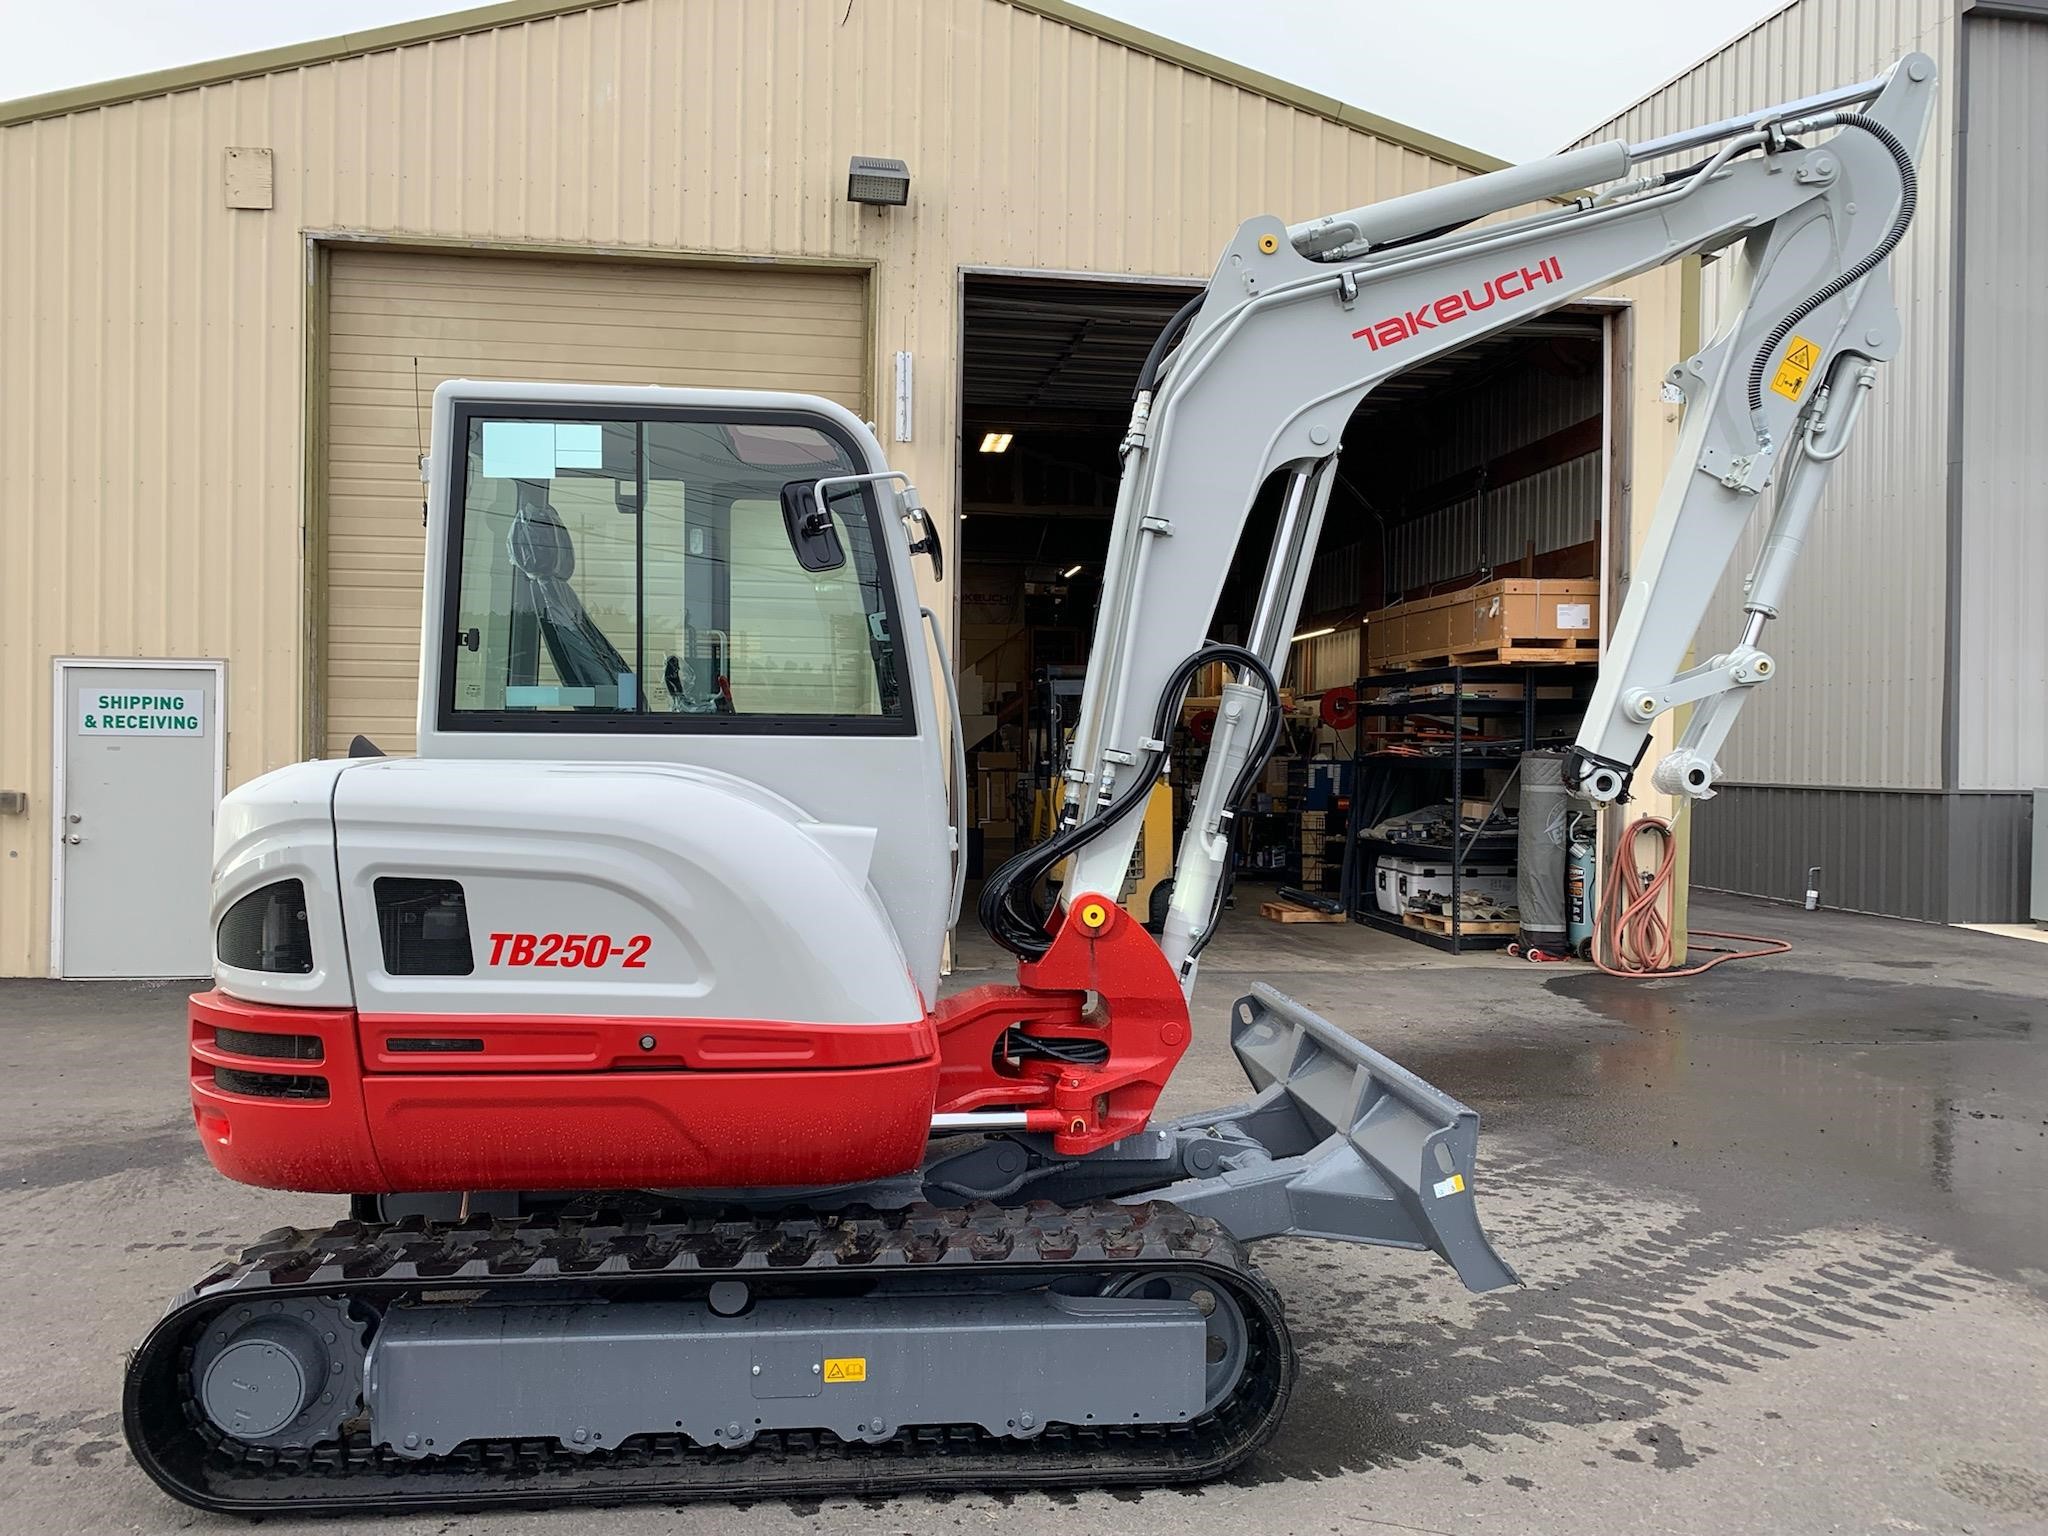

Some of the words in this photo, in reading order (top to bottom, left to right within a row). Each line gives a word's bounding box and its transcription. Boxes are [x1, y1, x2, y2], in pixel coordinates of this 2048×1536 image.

[99, 695, 184, 710] SHIPPING
[84, 714, 97, 728] &
[103, 715, 198, 729] RECEIVING
[489, 933, 652, 968] TB250-2
